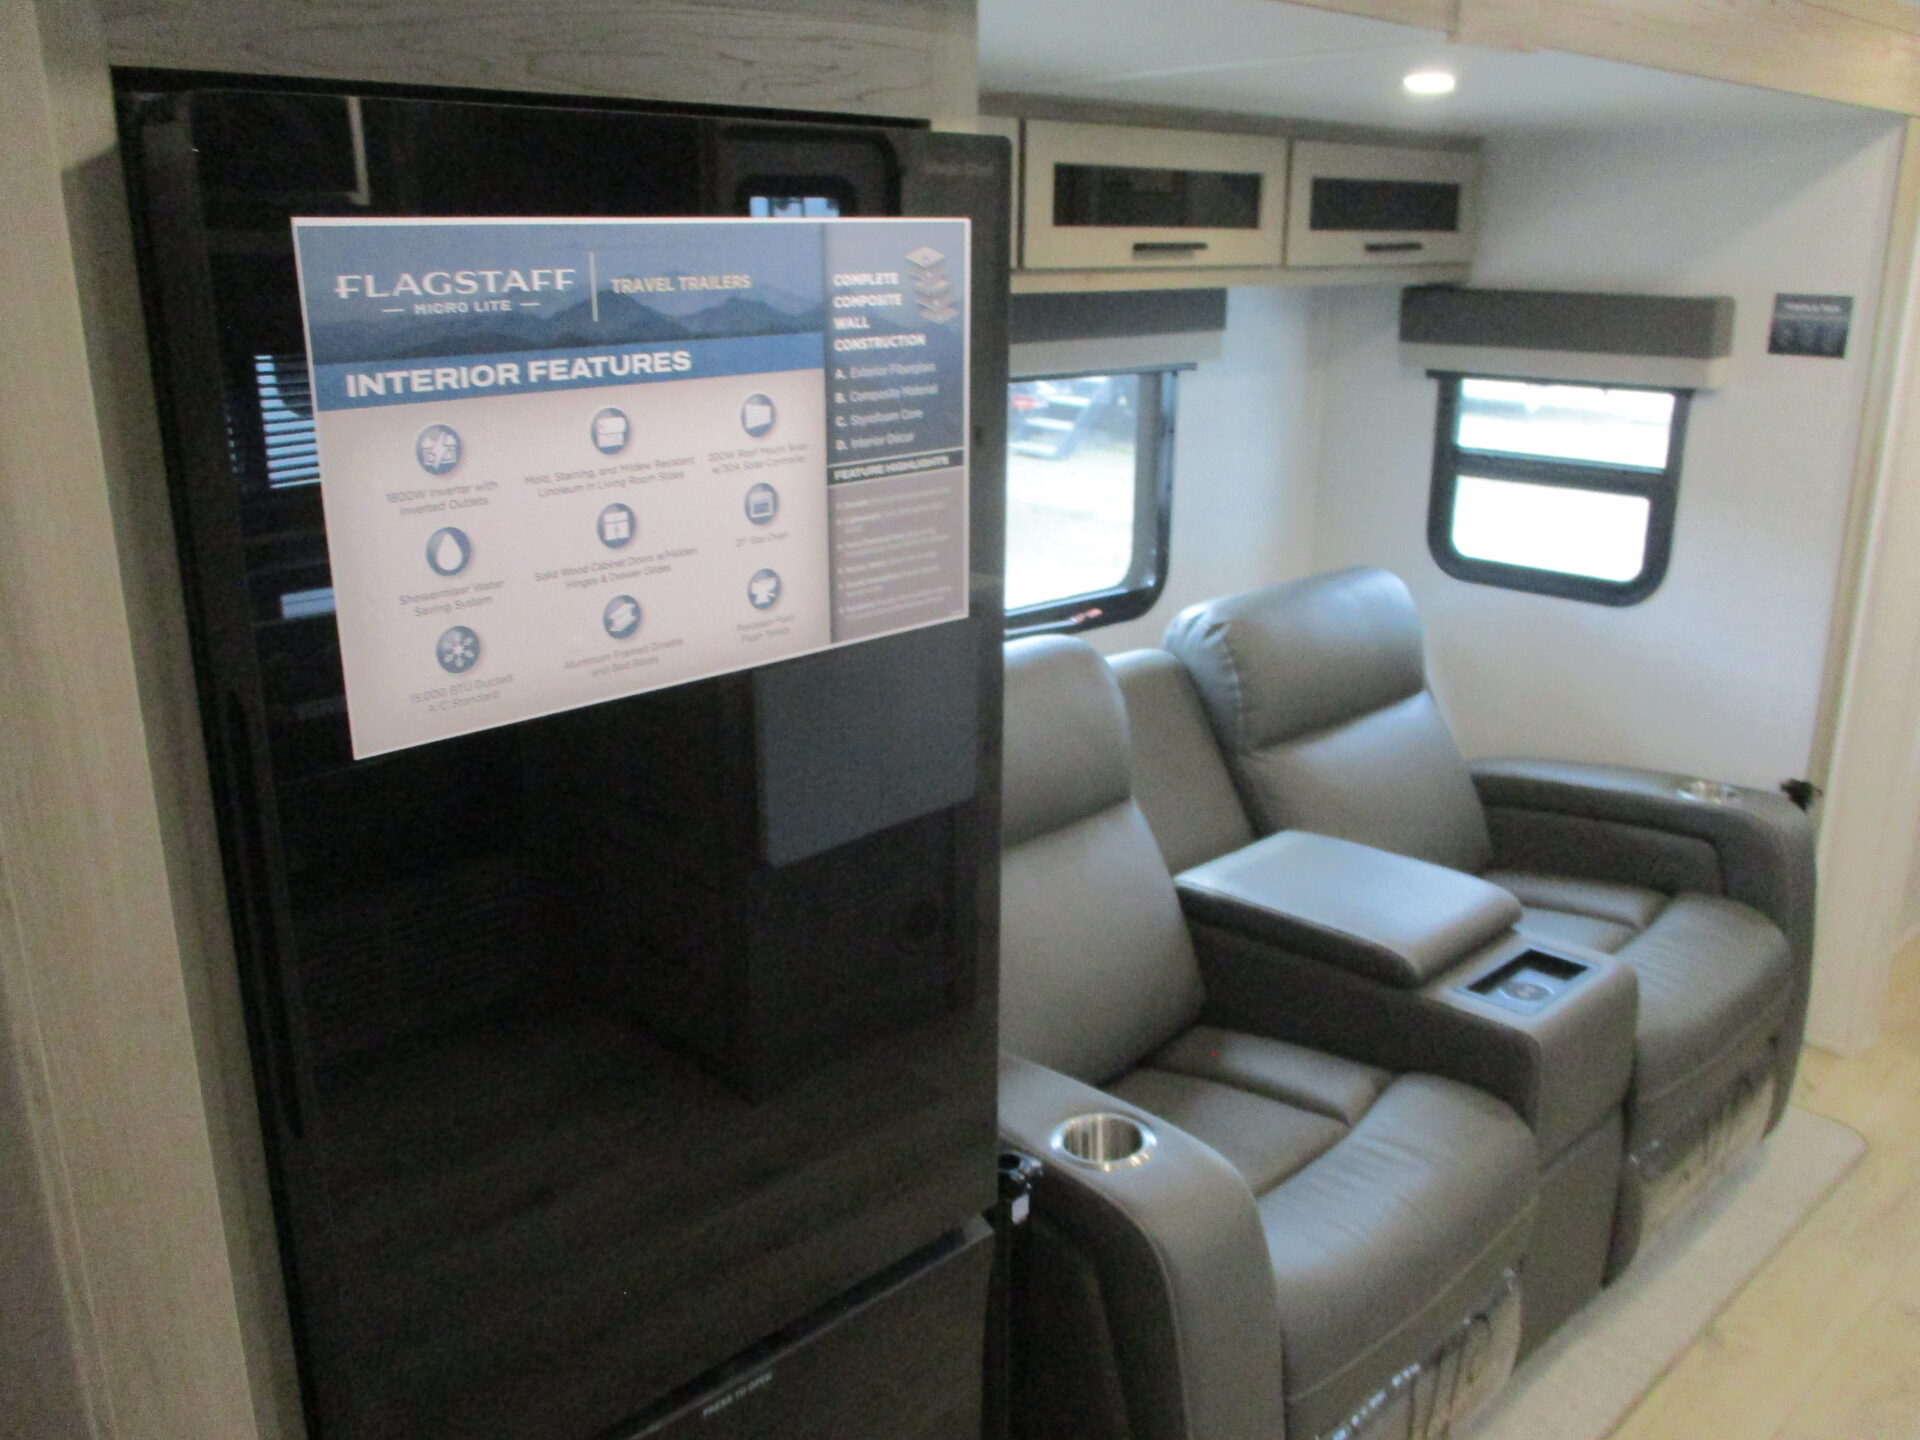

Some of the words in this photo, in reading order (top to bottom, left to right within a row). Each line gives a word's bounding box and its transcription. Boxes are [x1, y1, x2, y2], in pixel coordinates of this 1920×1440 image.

[334, 268, 577, 299] FLAGSTAFF
[610, 277, 675, 294] TRAVEL
[677, 274, 752, 291] TRAILERS
[833, 272, 899, 287] COMPLETE
[413, 302, 469, 315] MICRO
[473, 300, 512, 313] LITE
[833, 293, 903, 308] COMPOSITE
[833, 316, 870, 330] WALL
[833, 333, 927, 352] CONSTRUCTION
[346, 363, 521, 398] INTERIOR
[528, 350, 692, 383] FEATURES
[834, 368, 847, 380] A.
